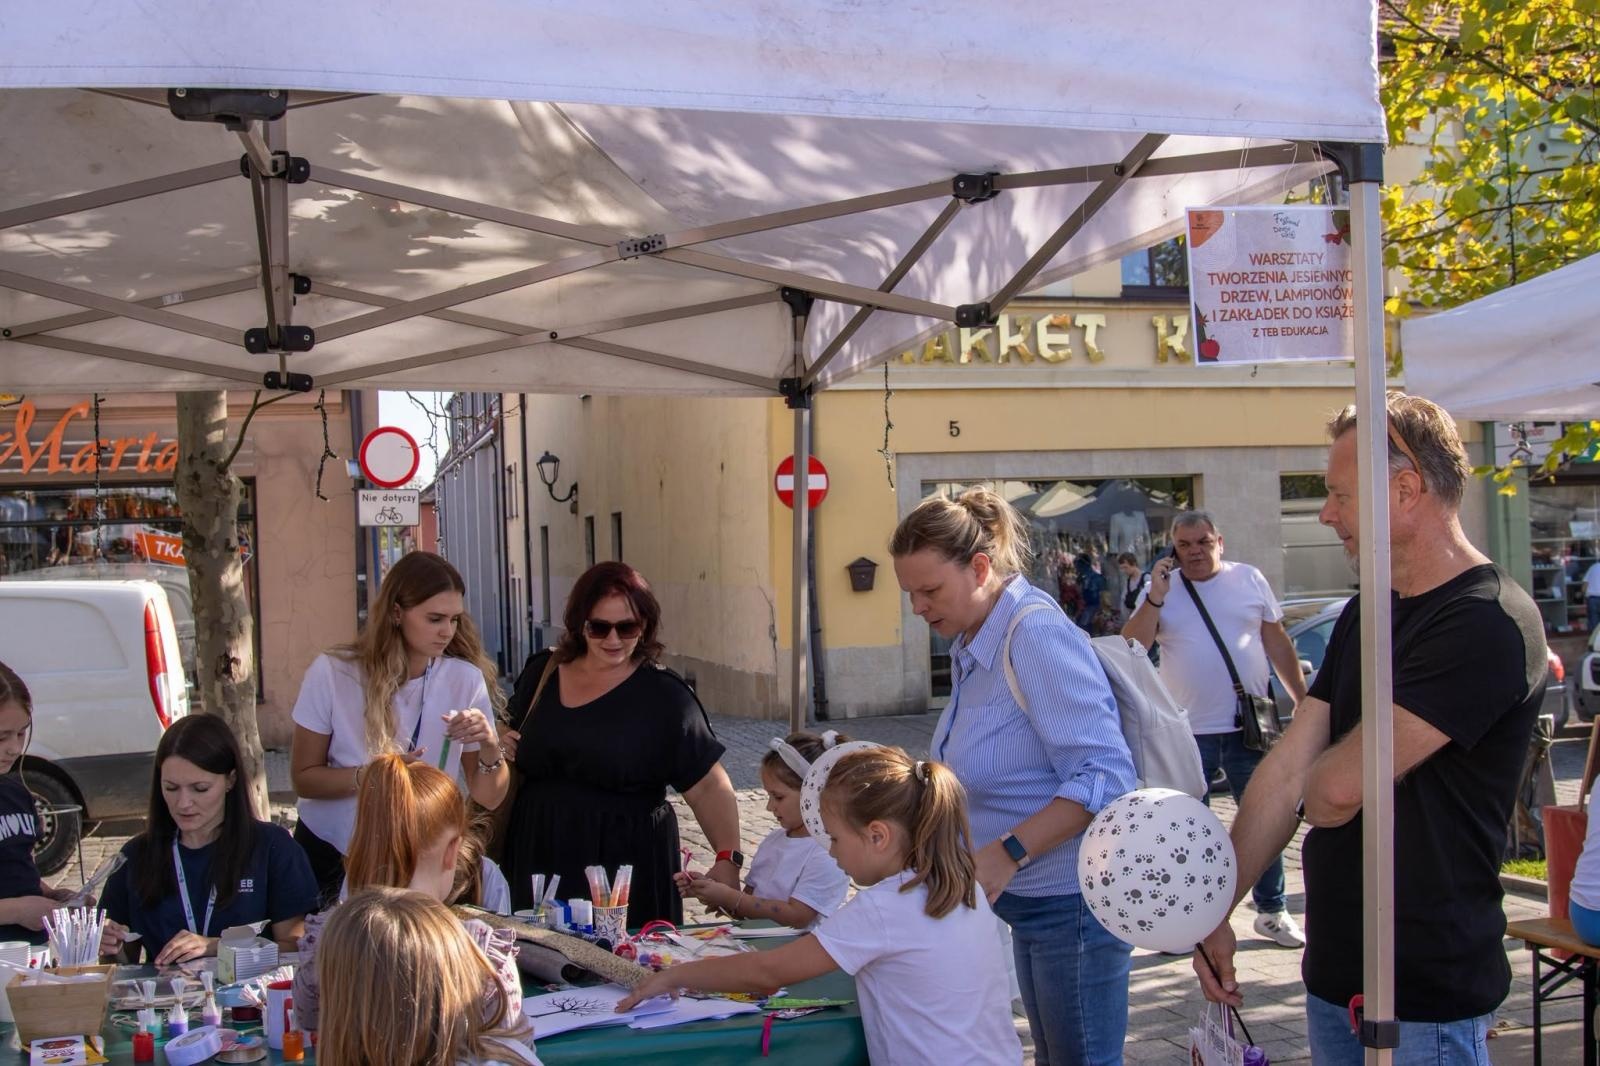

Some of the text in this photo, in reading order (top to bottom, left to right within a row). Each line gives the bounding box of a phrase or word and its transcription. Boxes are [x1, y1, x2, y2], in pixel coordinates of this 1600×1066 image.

[1249, 252, 1325, 266] WARSZTATY
[1208, 272, 1288, 286] TWORZENIA
[1220, 285, 1354, 304] DRZEW, LAMPIONÓW
[1212, 311, 1216, 323] I
[1219, 308, 1289, 322] ZAKŁADEK
[1293, 307, 1313, 319] DO
[902, 314, 1106, 363] ARKET
[1252, 325, 1329, 338] Z TEB EDUKACJA
[948, 420, 961, 438] 5
[362, 493, 416, 504] Nie dotyczy
